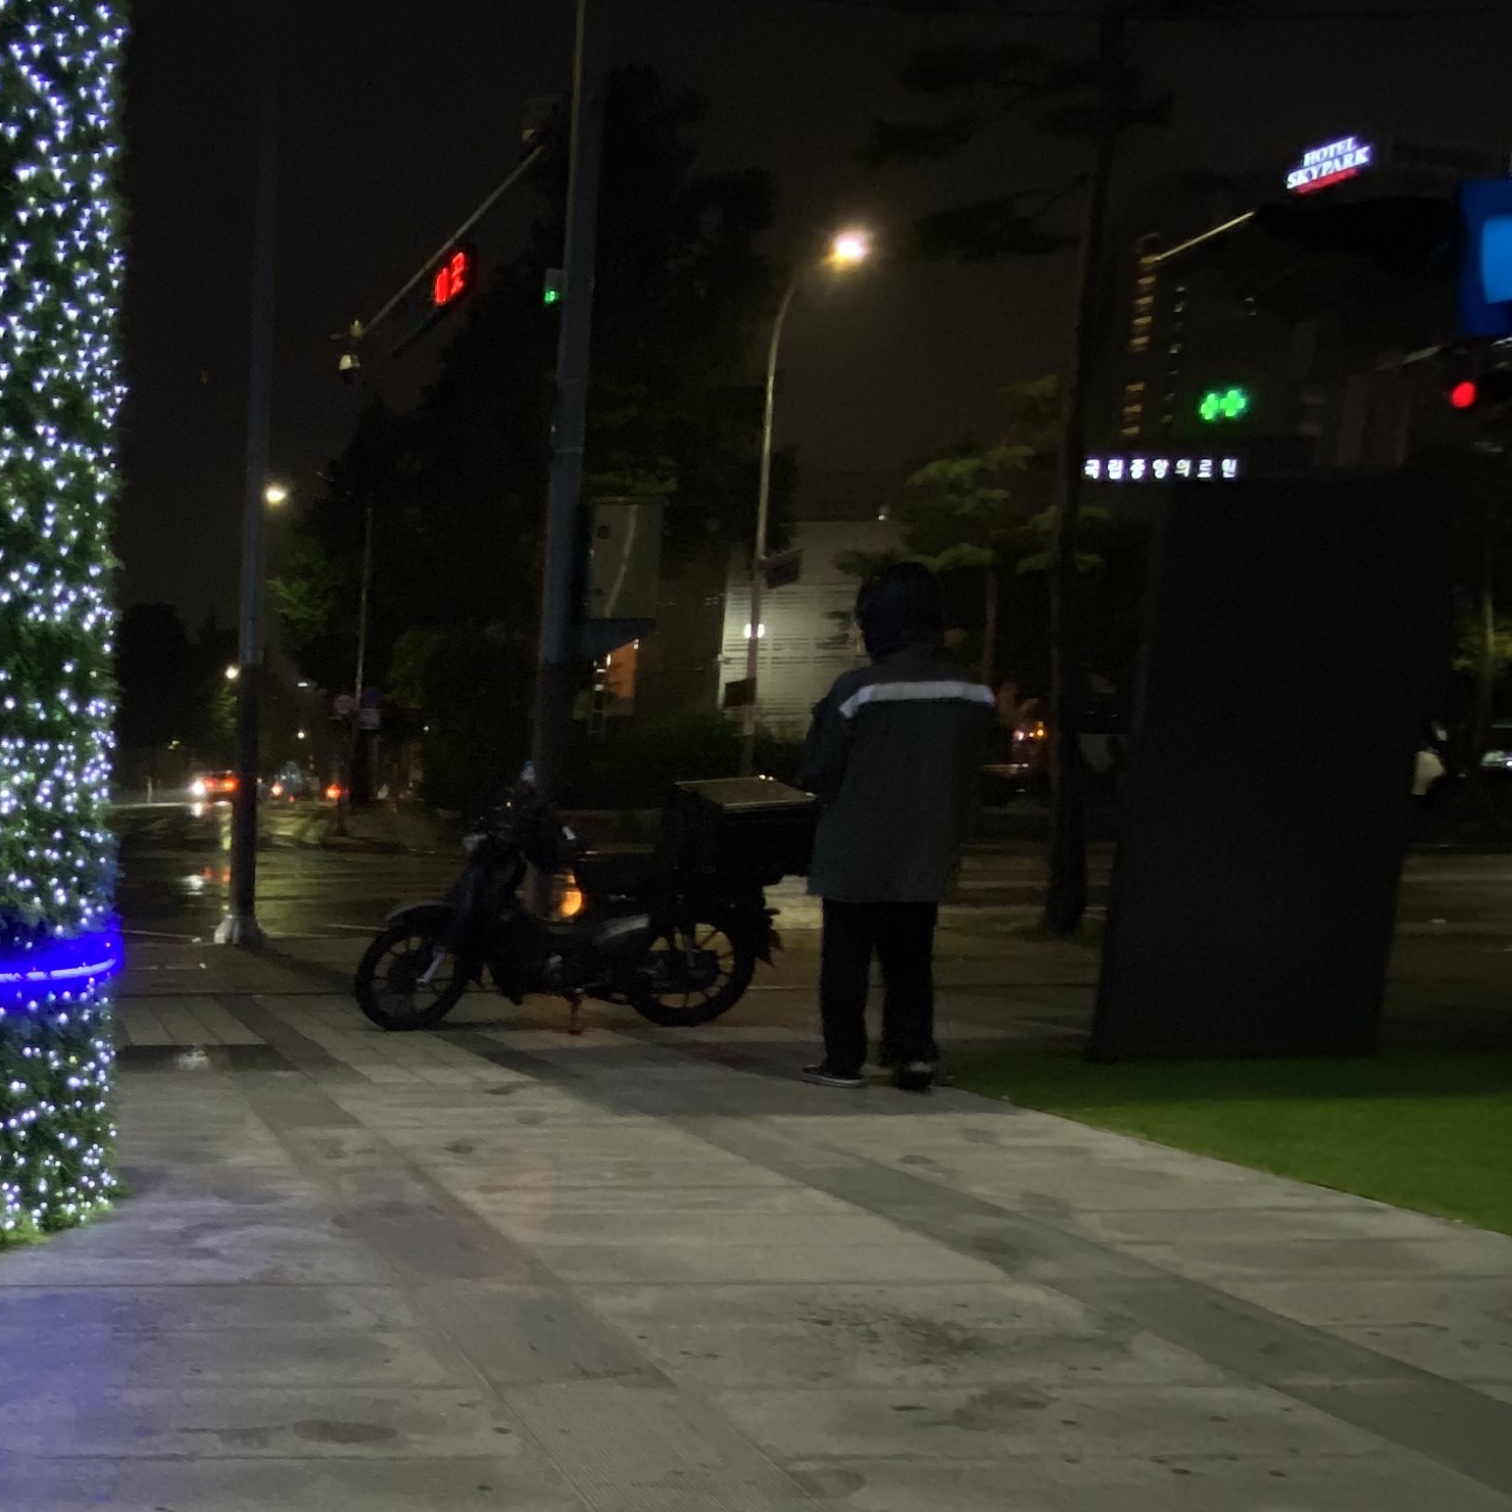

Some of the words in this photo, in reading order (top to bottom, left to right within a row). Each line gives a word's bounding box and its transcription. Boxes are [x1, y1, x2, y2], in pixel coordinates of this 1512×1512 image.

[1303, 136, 1357, 167] HOTEL
[1286, 145, 1370, 190] SKYPARK
[1083, 457, 1238, 480] 국립중앙의료원
